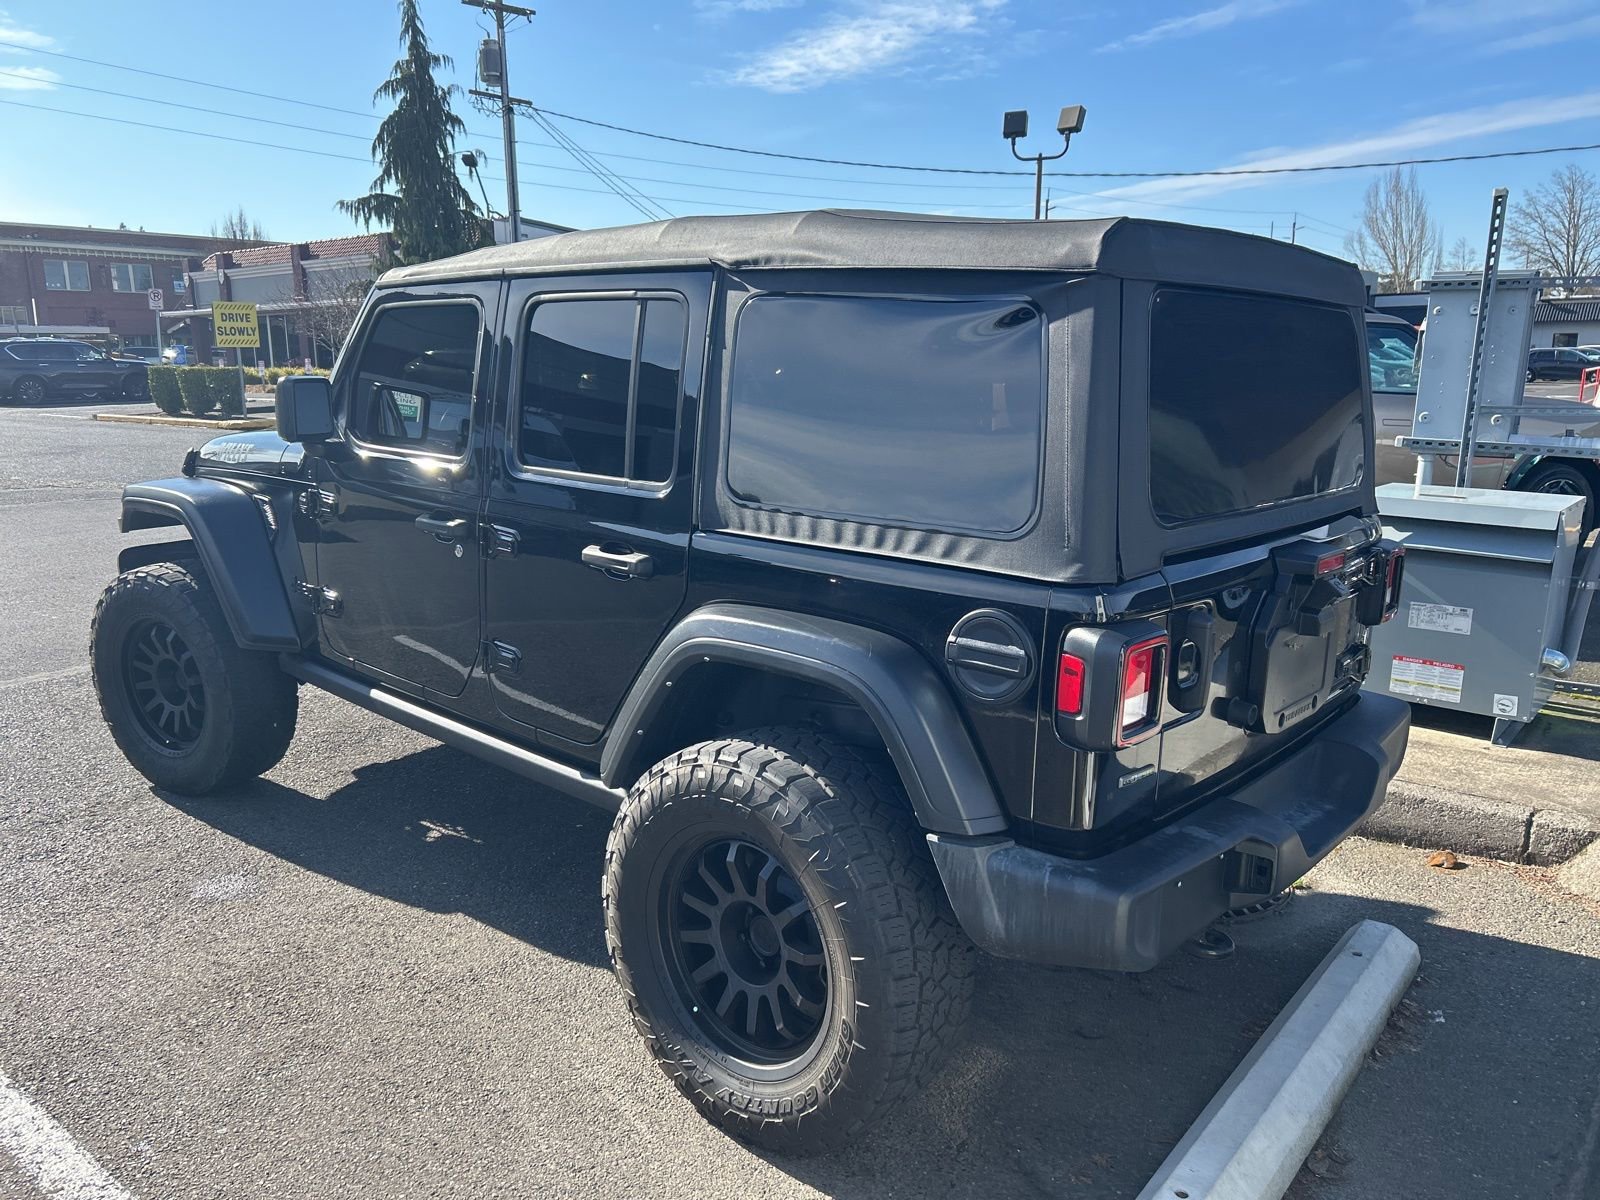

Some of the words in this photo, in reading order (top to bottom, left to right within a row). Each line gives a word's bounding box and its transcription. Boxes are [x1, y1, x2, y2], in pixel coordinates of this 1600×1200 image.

[220, 312, 251, 323] DRIVE
[217, 326, 257, 337] SLOWLY
[1402, 656, 1424, 664] DANGER
[1432, 661, 1455, 669] PELIGRO
[819, 1016, 854, 1093] OPEN
[715, 1084, 820, 1115] COUNTRY
